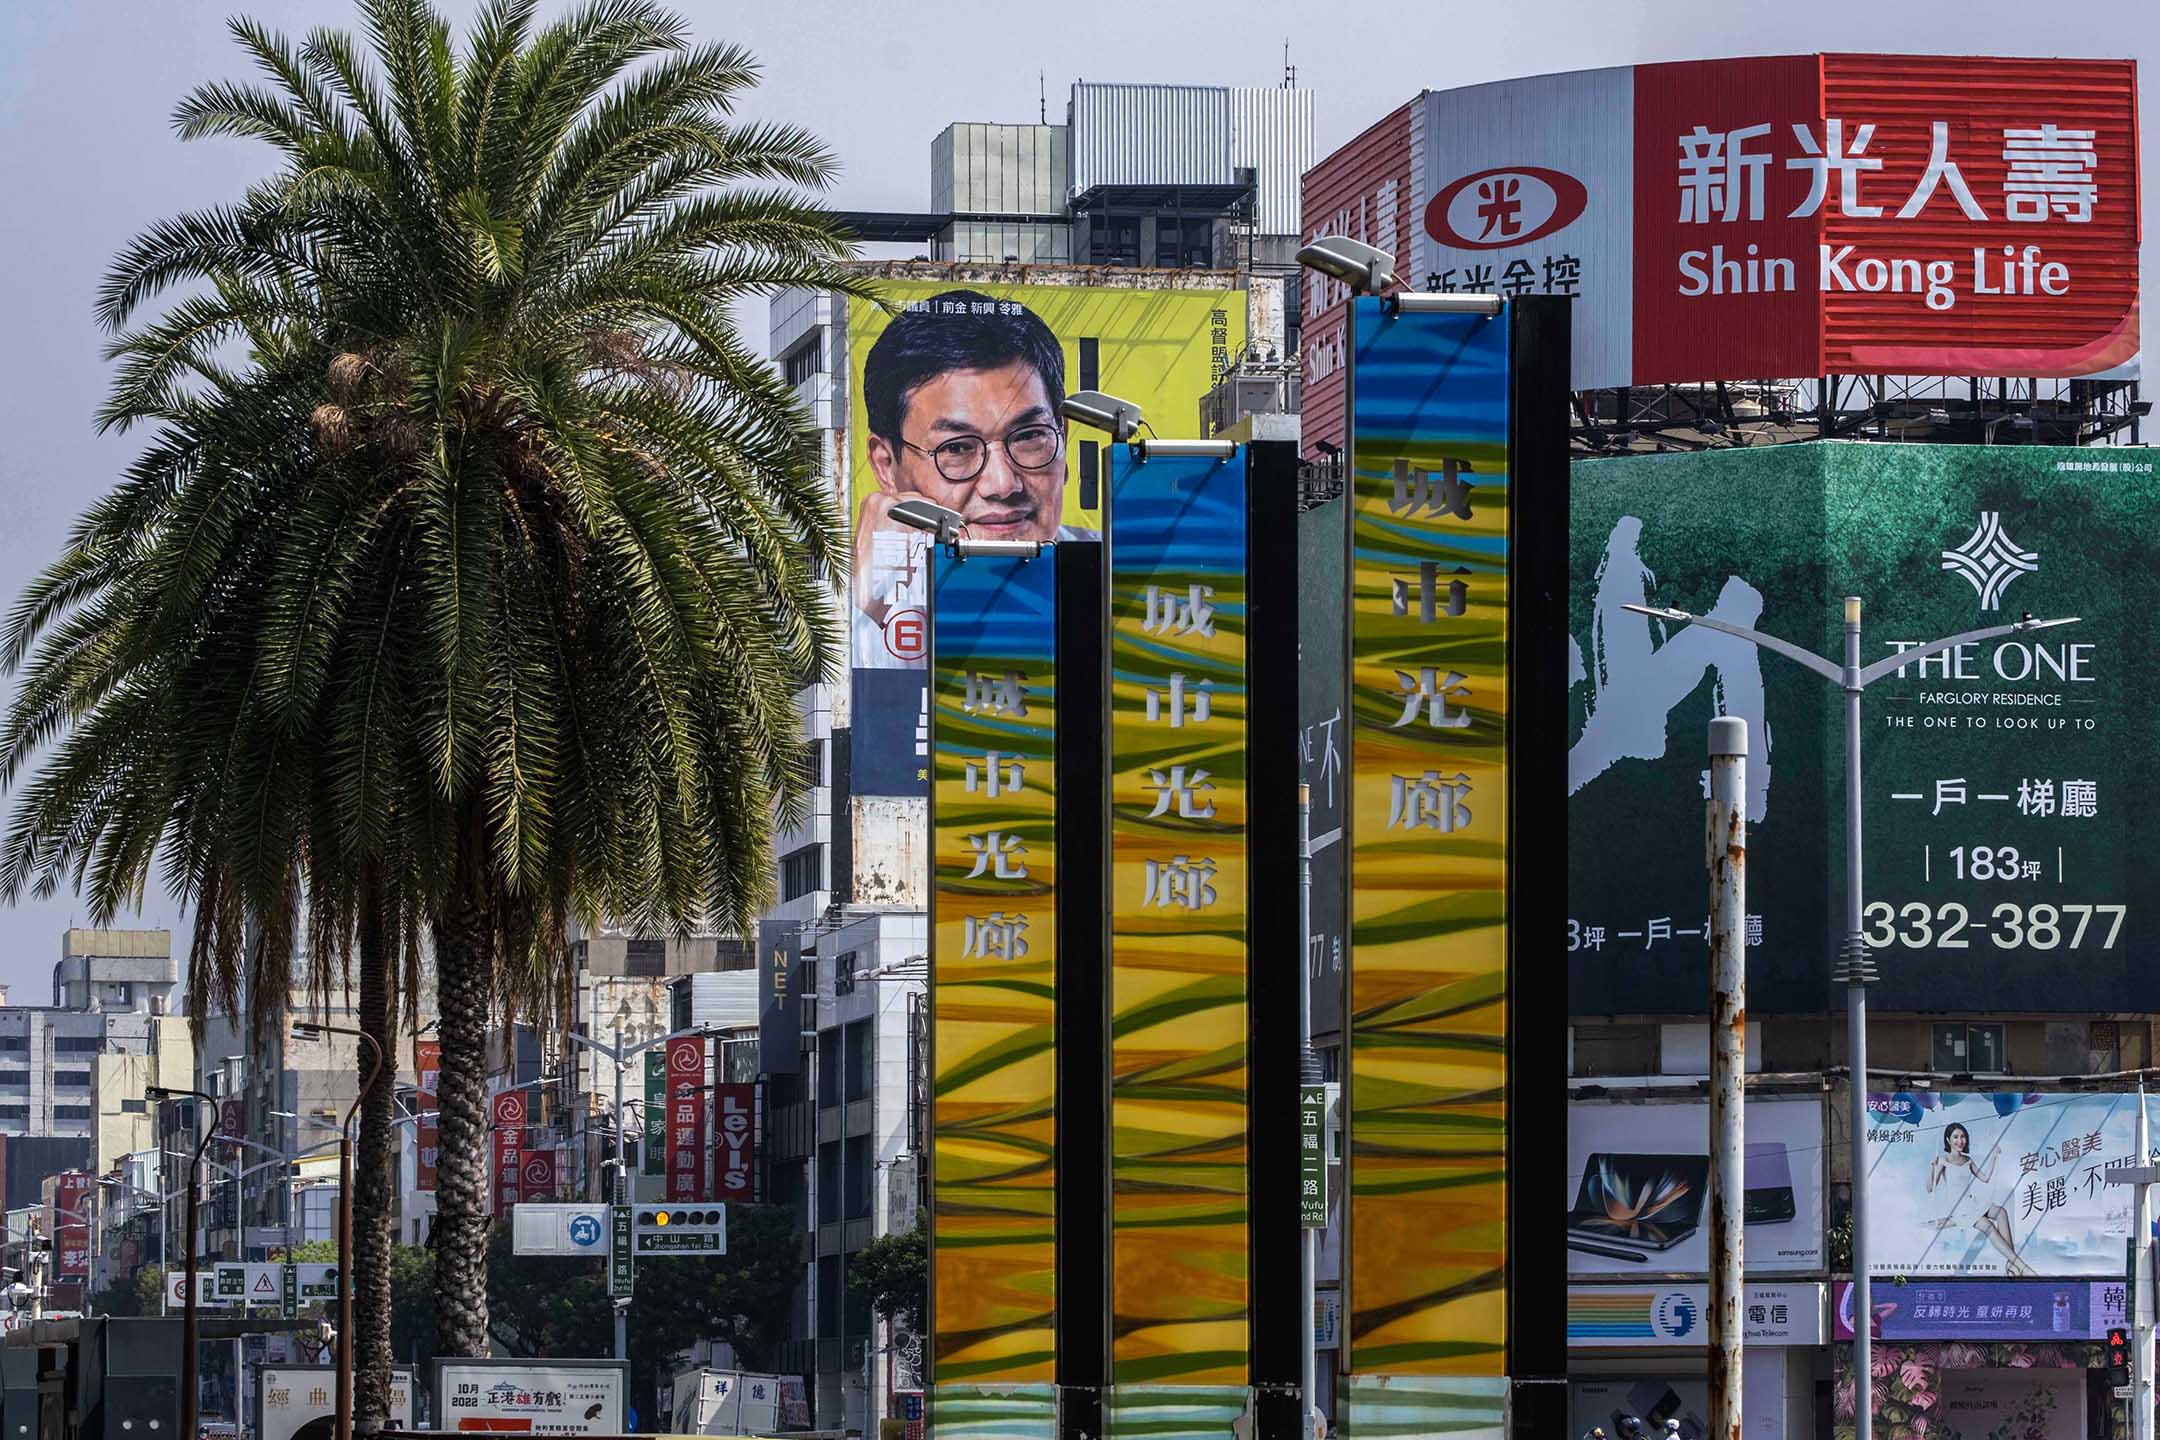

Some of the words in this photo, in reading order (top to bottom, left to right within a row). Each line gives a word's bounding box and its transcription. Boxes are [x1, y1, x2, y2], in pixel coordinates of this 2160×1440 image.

[1678, 118, 2098, 224] 新光人壽
[1477, 178, 1522, 241] 光
[1426, 254, 1581, 298] 新光金控
[1678, 244, 1796, 296] Shin
[1819, 245, 1956, 311] Kong
[1974, 245, 2070, 296] Life
[942, 301, 967, 315] 前金
[971, 302, 994, 315] 新興
[999, 303, 1024, 316] 苓雅
[1309, 332, 1333, 385] Shin
[895, 620, 922, 651] 6
[1386, 456, 1475, 833] 城市光廊
[1885, 641, 1980, 679] THE
[1993, 641, 2096, 682] ONE
[1919, 692, 1989, 705] FARGLORY
[1992, 693, 2062, 706] RESIDENCE
[1886, 716, 1915, 728] THE
[1923, 716, 1957, 728] ONE
[1966, 716, 1987, 729] TO
[1996, 717, 2039, 729] LOOK
[2047, 718, 2066, 730] UP
[2075, 718, 2096, 730] TO
[1141, 583, 1218, 910] 城市光廊
[961, 670, 1029, 961] 城市光廊
[1891, 777, 2098, 818] 一戶一梯廳
[1949, 845, 2042, 882] 183坪
[1863, 901, 2127, 950] 332-3877
[774, 950, 788, 1011] NET
[502, 1129, 519, 1214] 金品運動
[1302, 1111, 1319, 1196] 五福二路
[2019, 1131, 2103, 1176] 安心醫美
[653, 1234, 714, 1243] 中山一路
[1777, 1249, 1818, 1257] samsung.com
[1748, 1304, 1789, 1324] 電信
[451, 1396, 479, 1408] 2022
[458, 1383, 480, 1395] 10月
